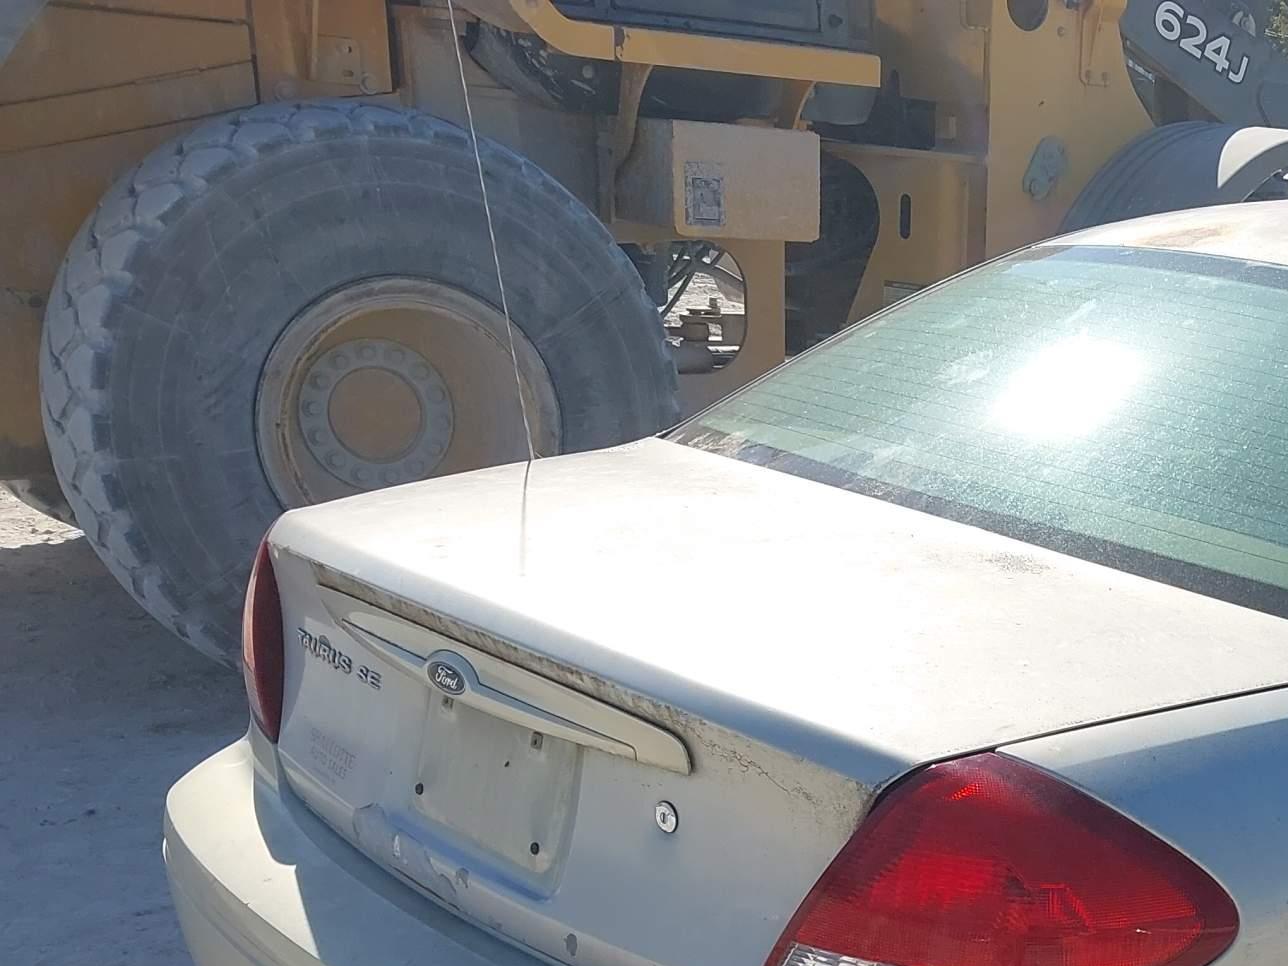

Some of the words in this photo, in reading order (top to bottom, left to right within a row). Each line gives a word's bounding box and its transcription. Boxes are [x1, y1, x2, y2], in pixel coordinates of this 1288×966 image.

[1154, 0, 1249, 83] 624J
[297, 628, 352, 675] TAURUS
[356, 665, 382, 691] SE
[435, 665, 459, 690] Ford
